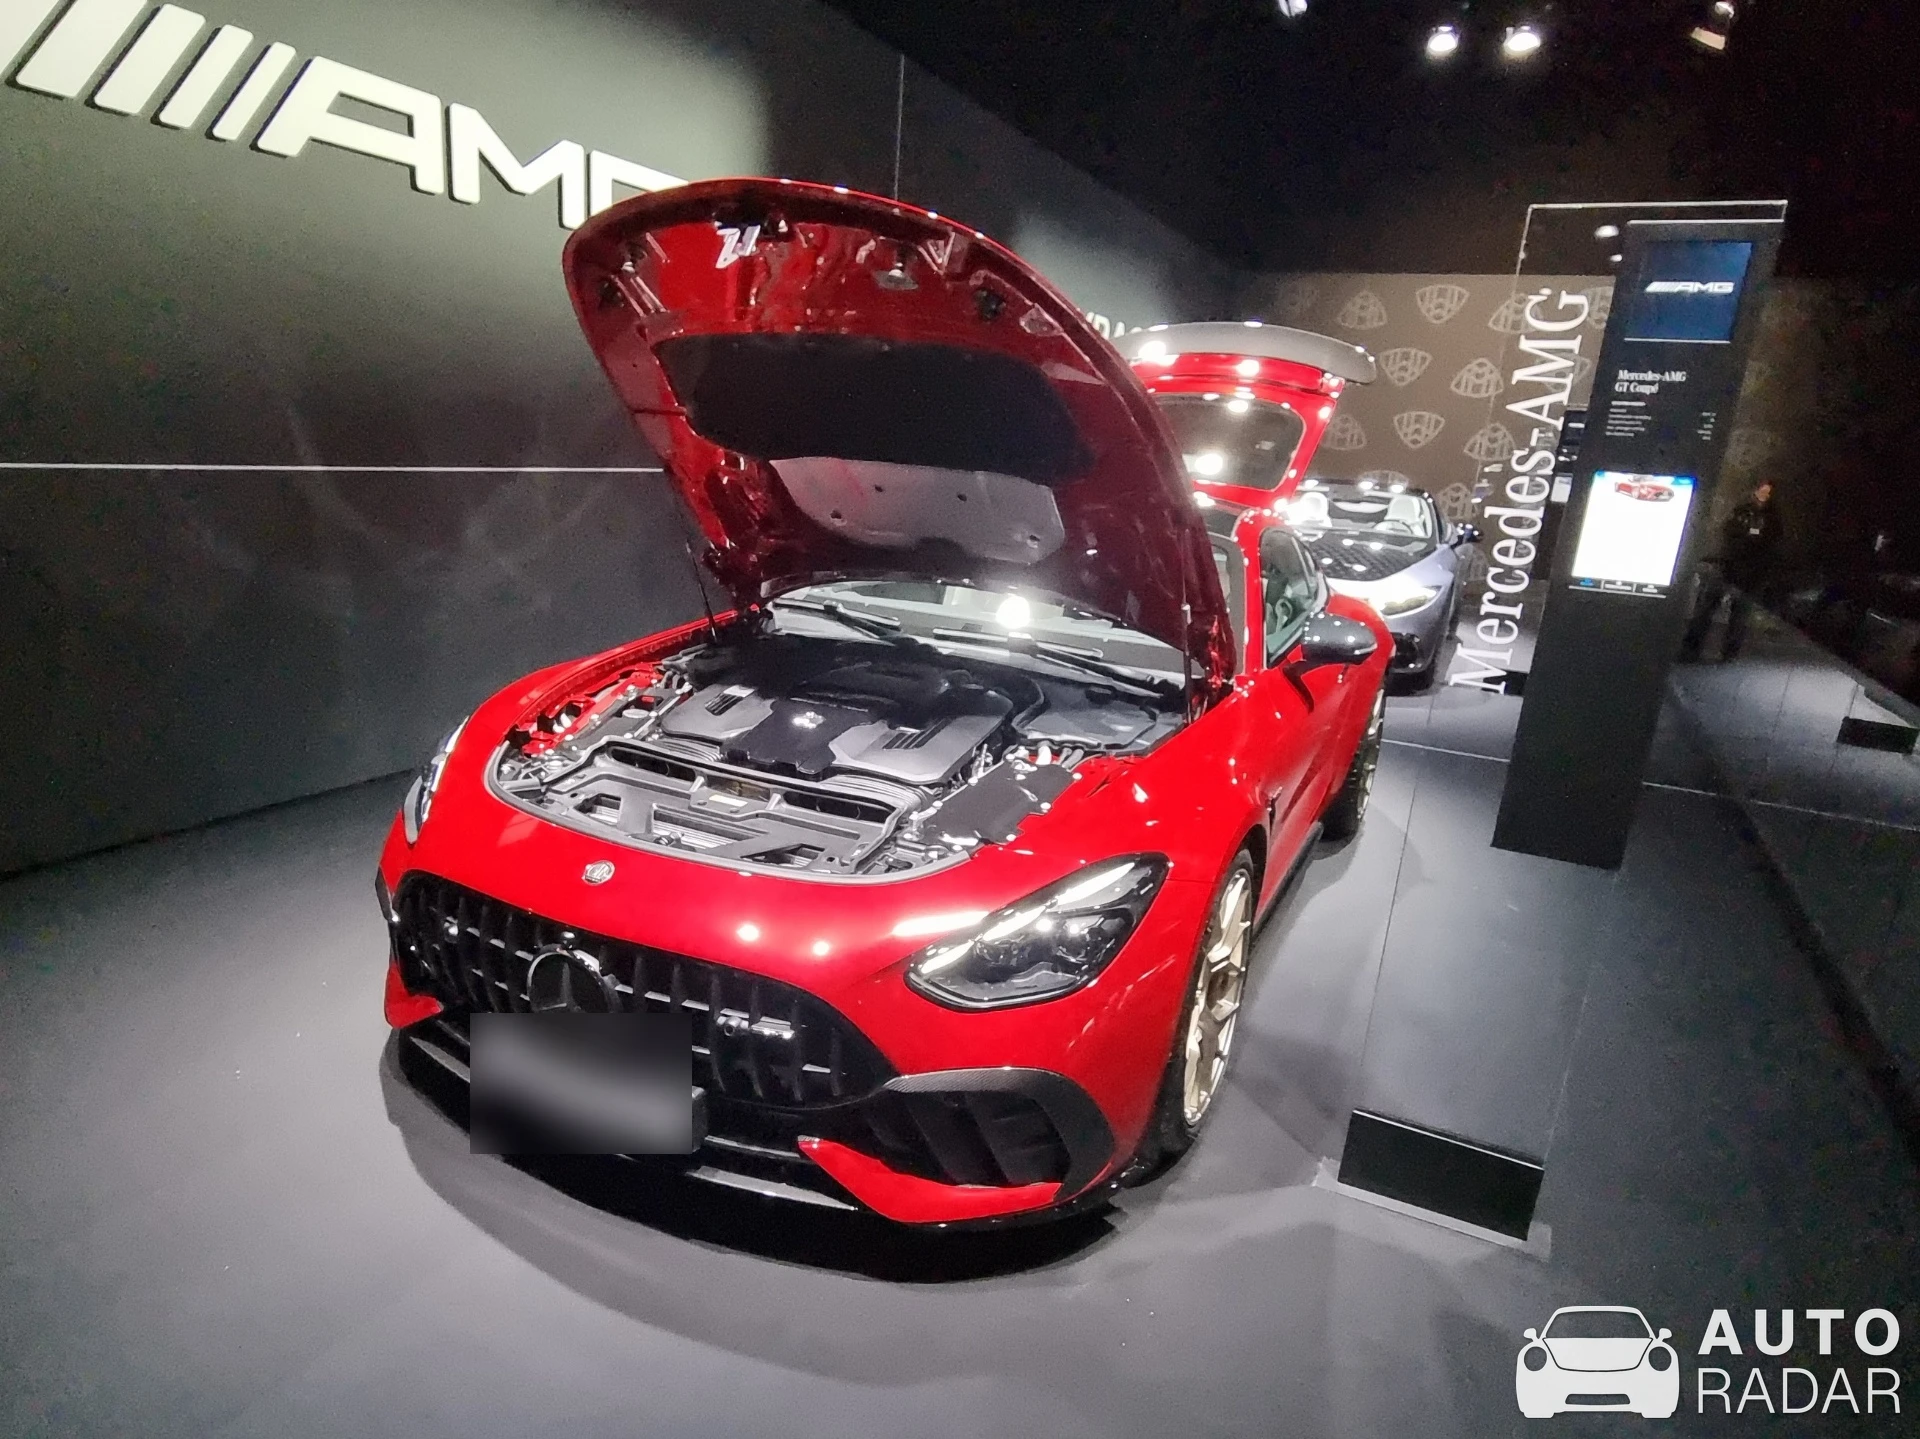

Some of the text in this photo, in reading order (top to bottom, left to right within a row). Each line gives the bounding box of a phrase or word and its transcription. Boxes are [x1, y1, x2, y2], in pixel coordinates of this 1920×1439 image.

[1674, 281, 1735, 293] AMG
[1617, 369, 1687, 382] Mercedes-AMG
[1614, 381, 1629, 393] GT
[1449, 287, 1590, 695] Mercedes-AMG
